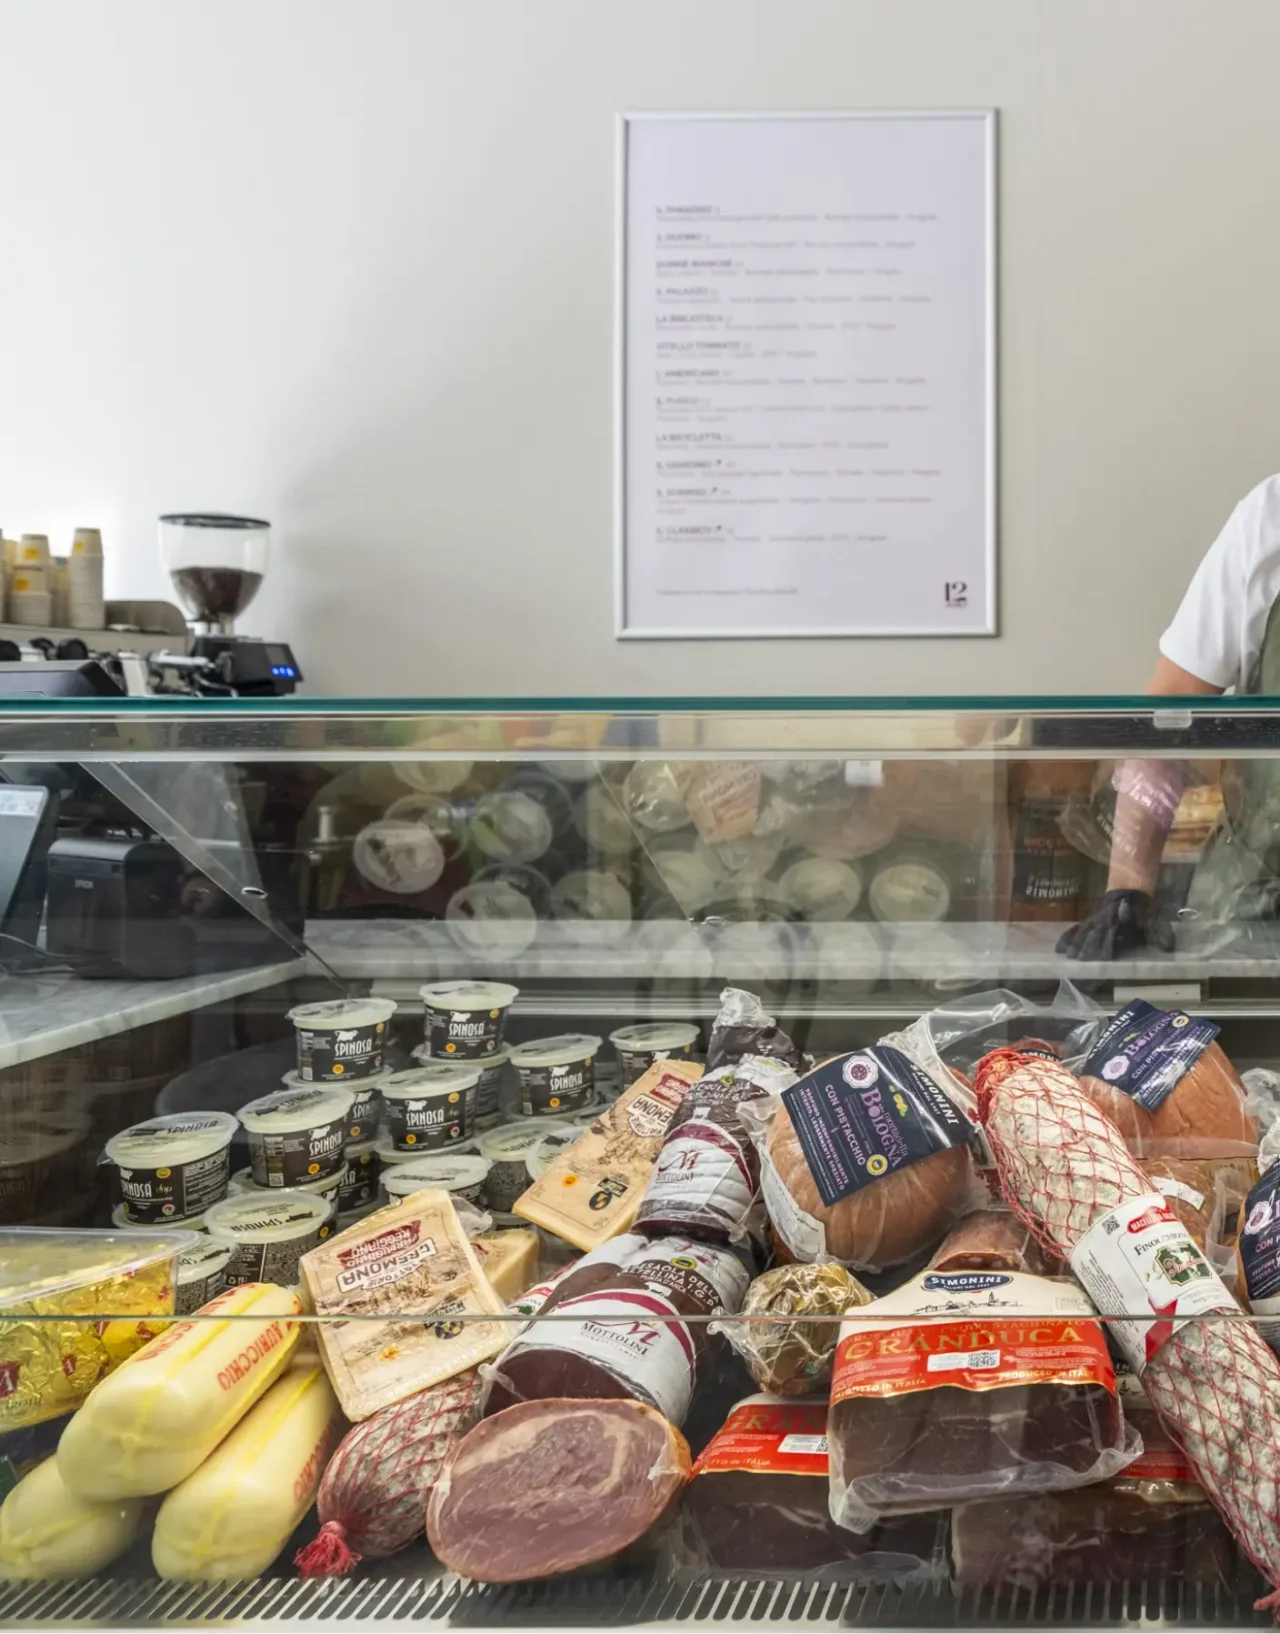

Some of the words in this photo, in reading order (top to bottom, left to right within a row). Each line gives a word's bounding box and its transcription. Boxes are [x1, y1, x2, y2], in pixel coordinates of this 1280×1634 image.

[449, 1022, 485, 1037] SPINOSA
[335, 1038, 372, 1057] SPINOSA
[550, 1072, 583, 1092] SPINOSA
[1132, 1062, 1147, 1079] CON
[805, 1088, 820, 1117] PROFUMO
[910, 1063, 960, 1125] SIMONINI
[406, 1108, 444, 1127] SPINOSA
[631, 1096, 674, 1126] EMONA
[167, 1120, 219, 1135] SPINOSA
[825, 1084, 839, 1107] CON
[834, 1107, 866, 1167] PISTACCHIO
[860, 1087, 903, 1168] BOLOGNA
[884, 1111, 909, 1158] mortadella
[309, 1130, 342, 1157] SPINOSA
[121, 1180, 152, 1198] PINOSA
[231, 1217, 283, 1232] SPINOSA
[351, 1228, 411, 1257] REGGIANO
[1255, 1238, 1274, 1253] CON
[342, 1242, 431, 1286] CREMONA
[931, 1276, 1002, 1288] SIMONINI
[580, 1322, 649, 1356] MOTTOLINI
[845, 1326, 1084, 1361] GRANDUCA
[217, 1320, 284, 1391] AURICCHIO
